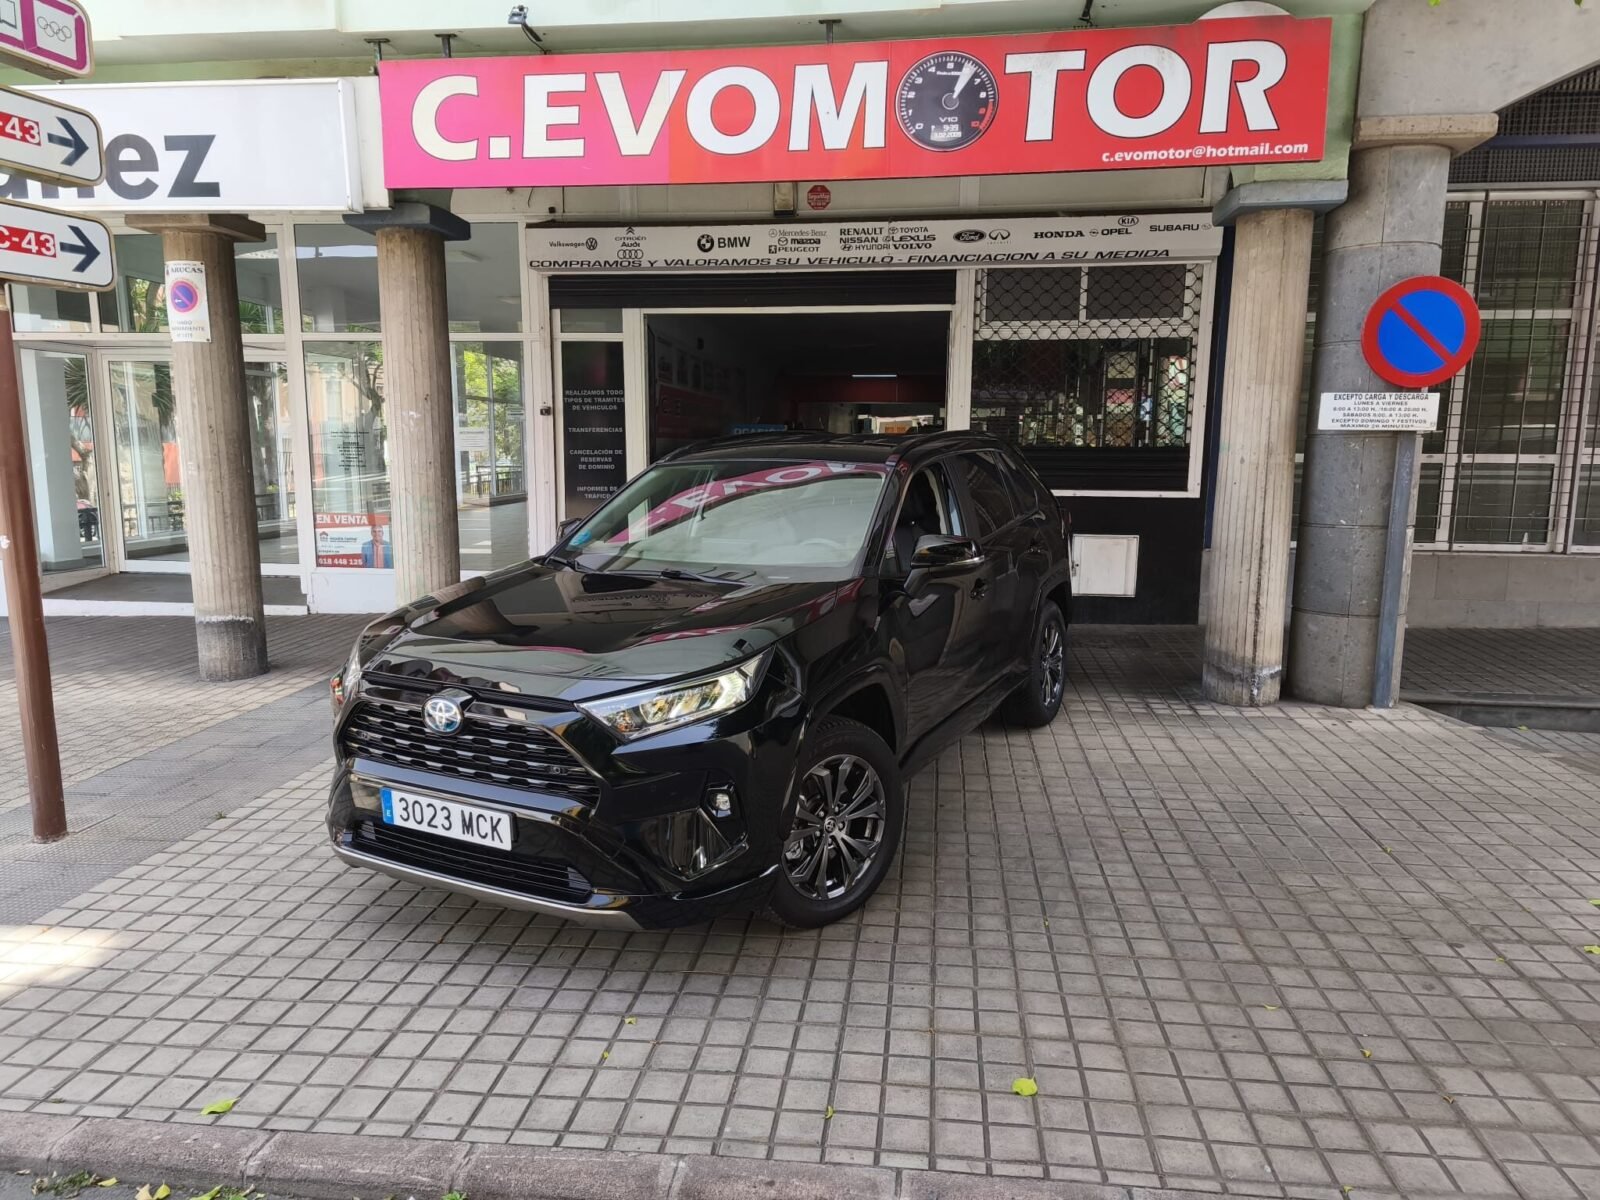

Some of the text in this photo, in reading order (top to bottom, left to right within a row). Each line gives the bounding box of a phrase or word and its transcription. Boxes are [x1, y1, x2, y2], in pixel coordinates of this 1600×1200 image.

[1102, 143, 1309, 162] c.evomotor@hotmail.com
[840, 227, 884, 236] RENAULT
[899, 226, 929, 234] TOYOTA
[1100, 228, 1133, 236] OPEL
[1149, 224, 1200, 232] SUBARU
[778, 229, 827, 237] Mercedes-Benz
[1033, 230, 1085, 239] HONDA
[717, 236, 751, 248] BMW
[840, 236, 879, 244] NISSAN
[891, 234, 937, 242] LEXUS
[548, 241, 585, 249] Volkswagen
[893, 242, 932, 250] VOLVO
[529, 260, 642, 268] COMPRAMOS
[664, 258, 772, 266] VALORAMOS
[776, 257, 800, 266] SU
[807, 255, 894, 265] VEHICULO
[907, 252, 1039, 263] FINANCIACION
[1042, 252, 1056, 260] A
[1061, 251, 1088, 259] SU
[1095, 249, 1170, 259] MEDIDA
[1333, 393, 1363, 401] EXCEPTO
[316, 514, 369, 525] EN VENTA
[398, 797, 504, 844] 3023 MCK
